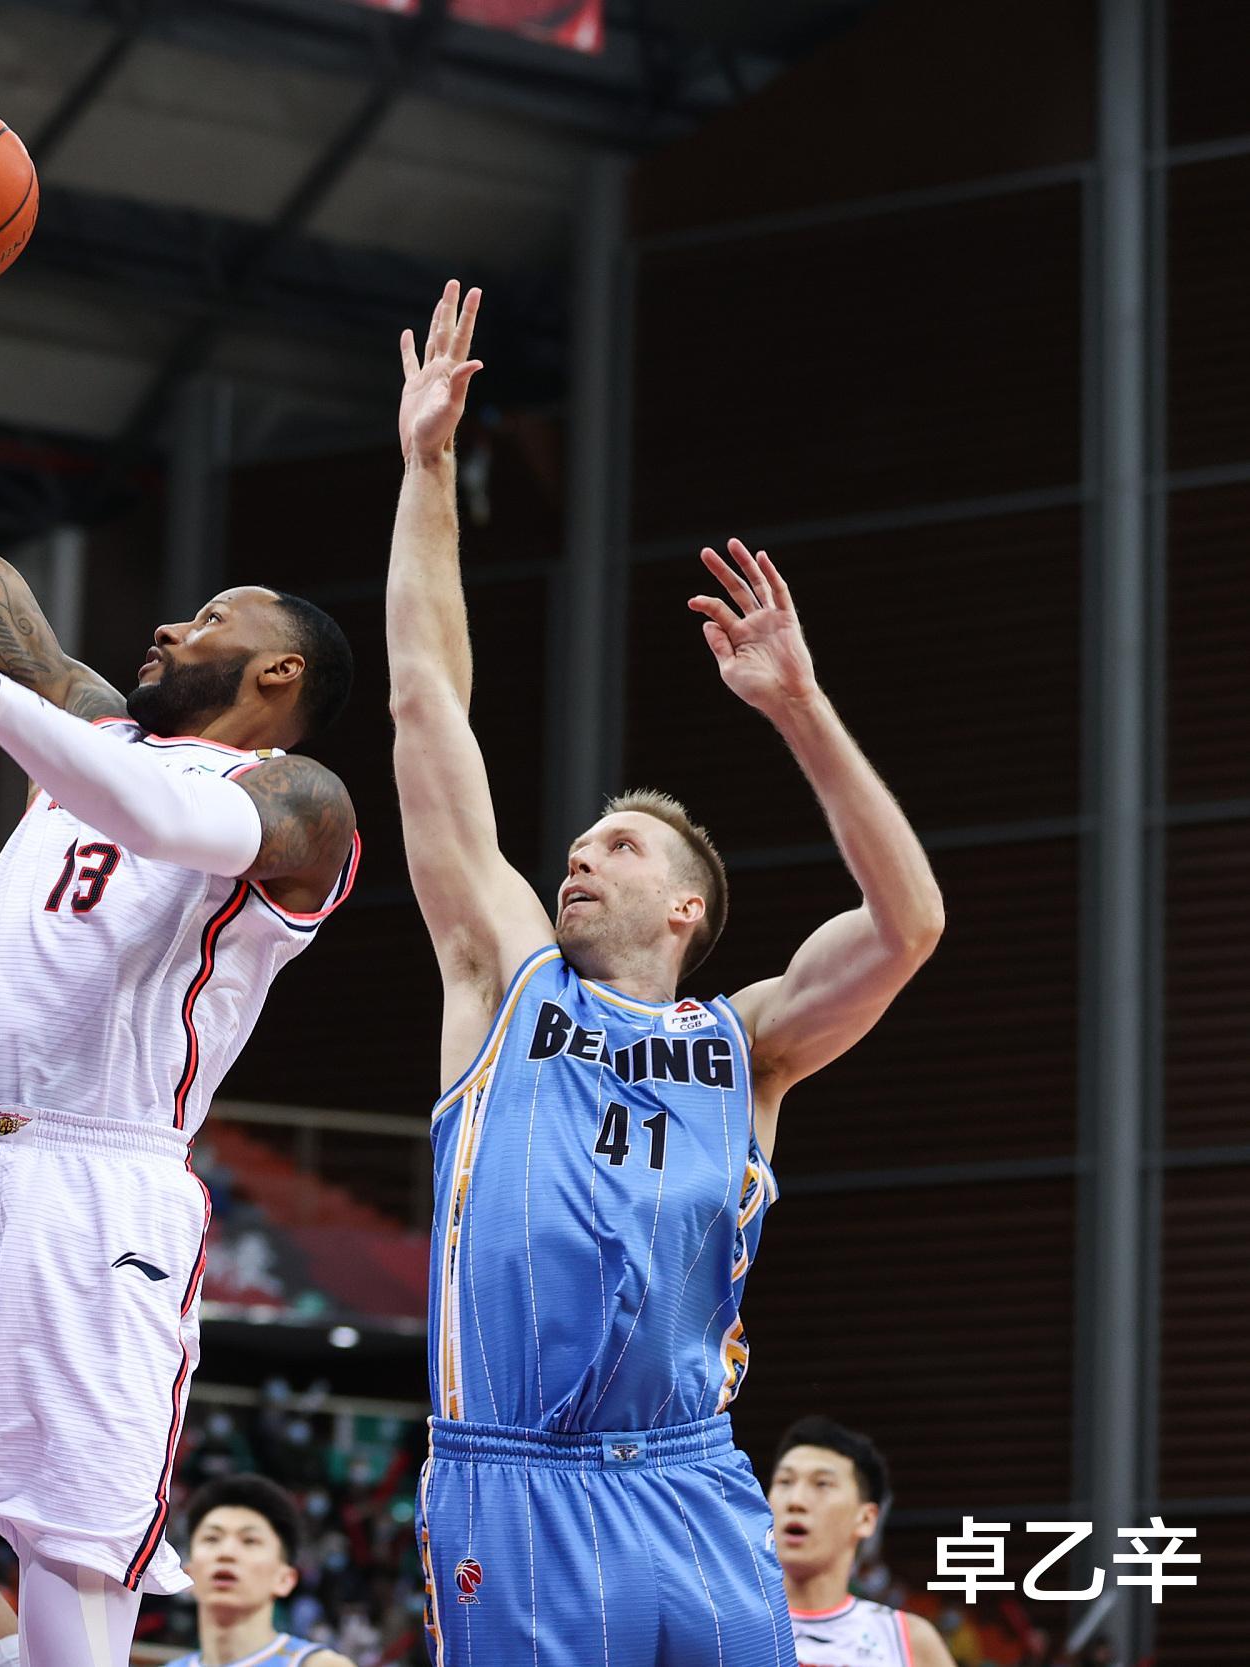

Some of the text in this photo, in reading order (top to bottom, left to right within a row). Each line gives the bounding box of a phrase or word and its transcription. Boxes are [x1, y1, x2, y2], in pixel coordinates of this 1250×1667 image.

[44, 837, 122, 913] 13
[679, 1020, 702, 1031] CGB
[595, 1100, 668, 1171] 41
